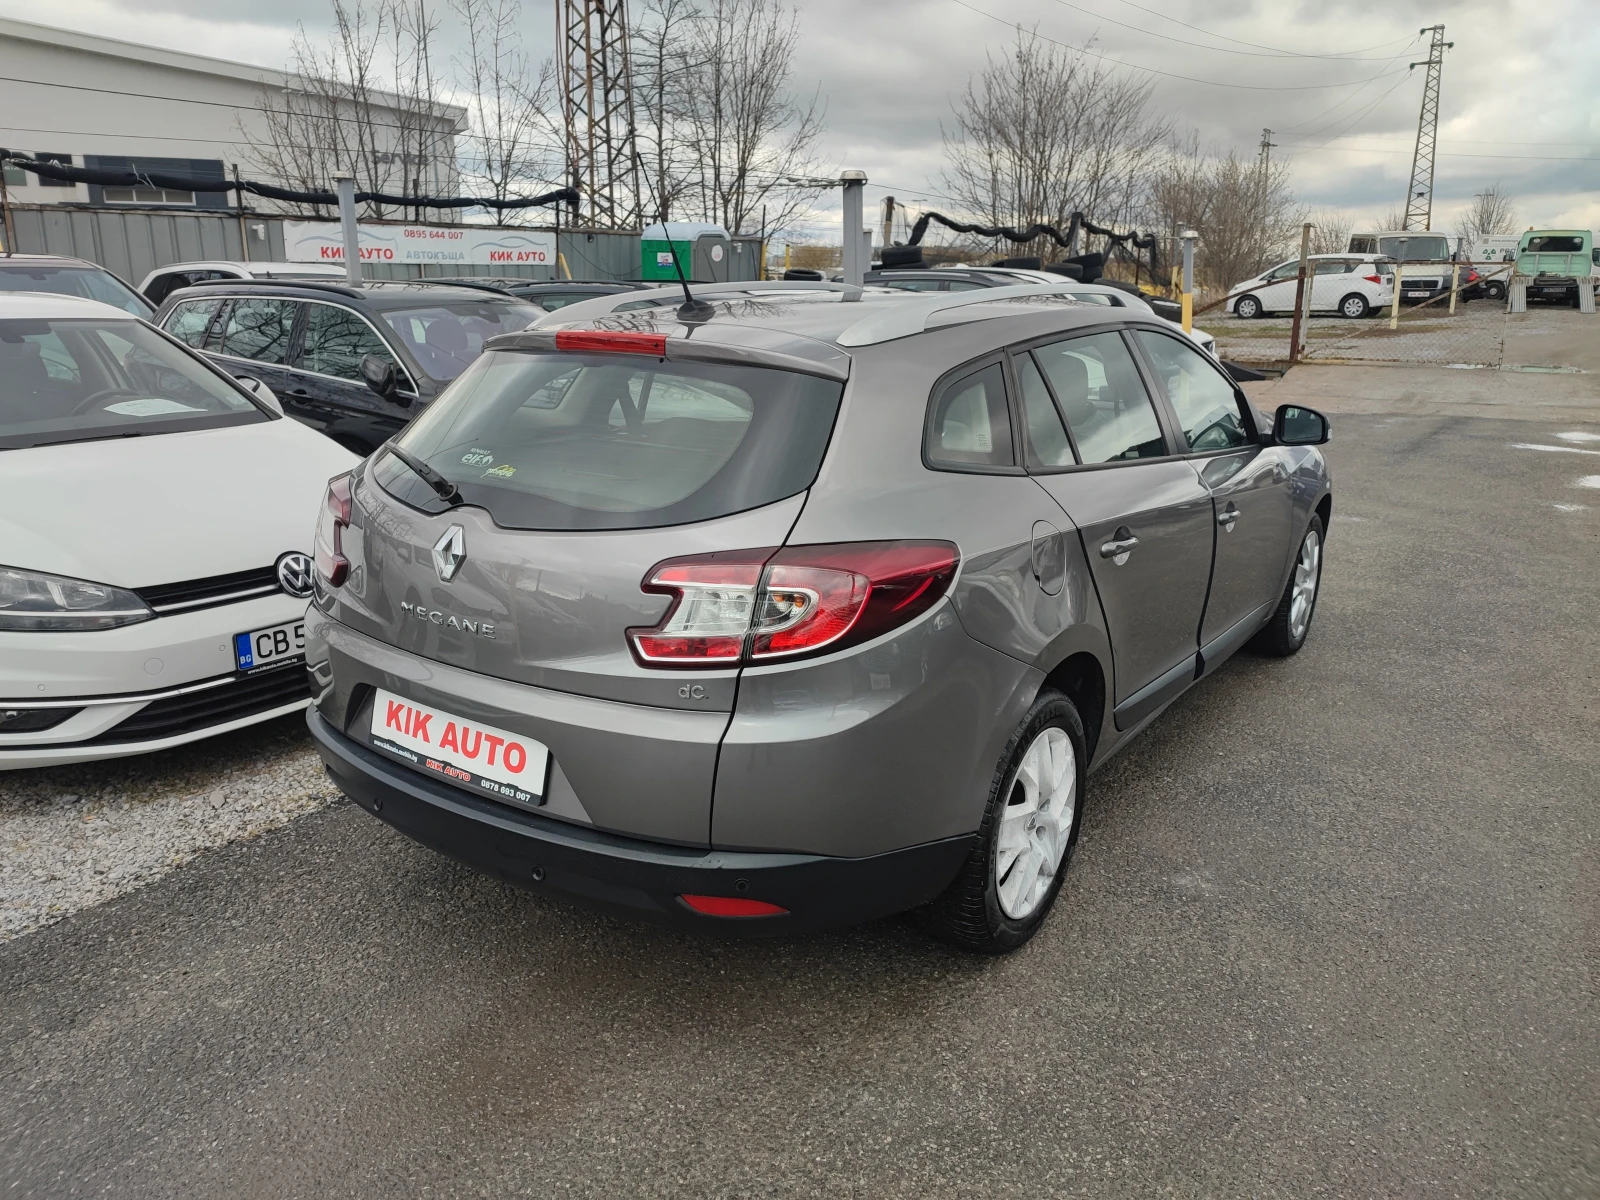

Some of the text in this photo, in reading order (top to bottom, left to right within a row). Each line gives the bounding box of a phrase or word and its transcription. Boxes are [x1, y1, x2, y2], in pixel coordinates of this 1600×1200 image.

[404, 229, 464, 240] 0895 644 007
[320, 246, 345, 259] КИ
[406, 250, 465, 262] АВТОКЪЩА
[490, 251, 546, 262] КИК АУТО
[401, 601, 496, 640] MEGANE
[256, 629, 290, 659] CB
[240, 654, 252, 665] BG
[385, 700, 527, 774] KIK AUTO
[426, 758, 471, 782] KIK AUTO
[481, 780, 531, 802] 0878 693 007
